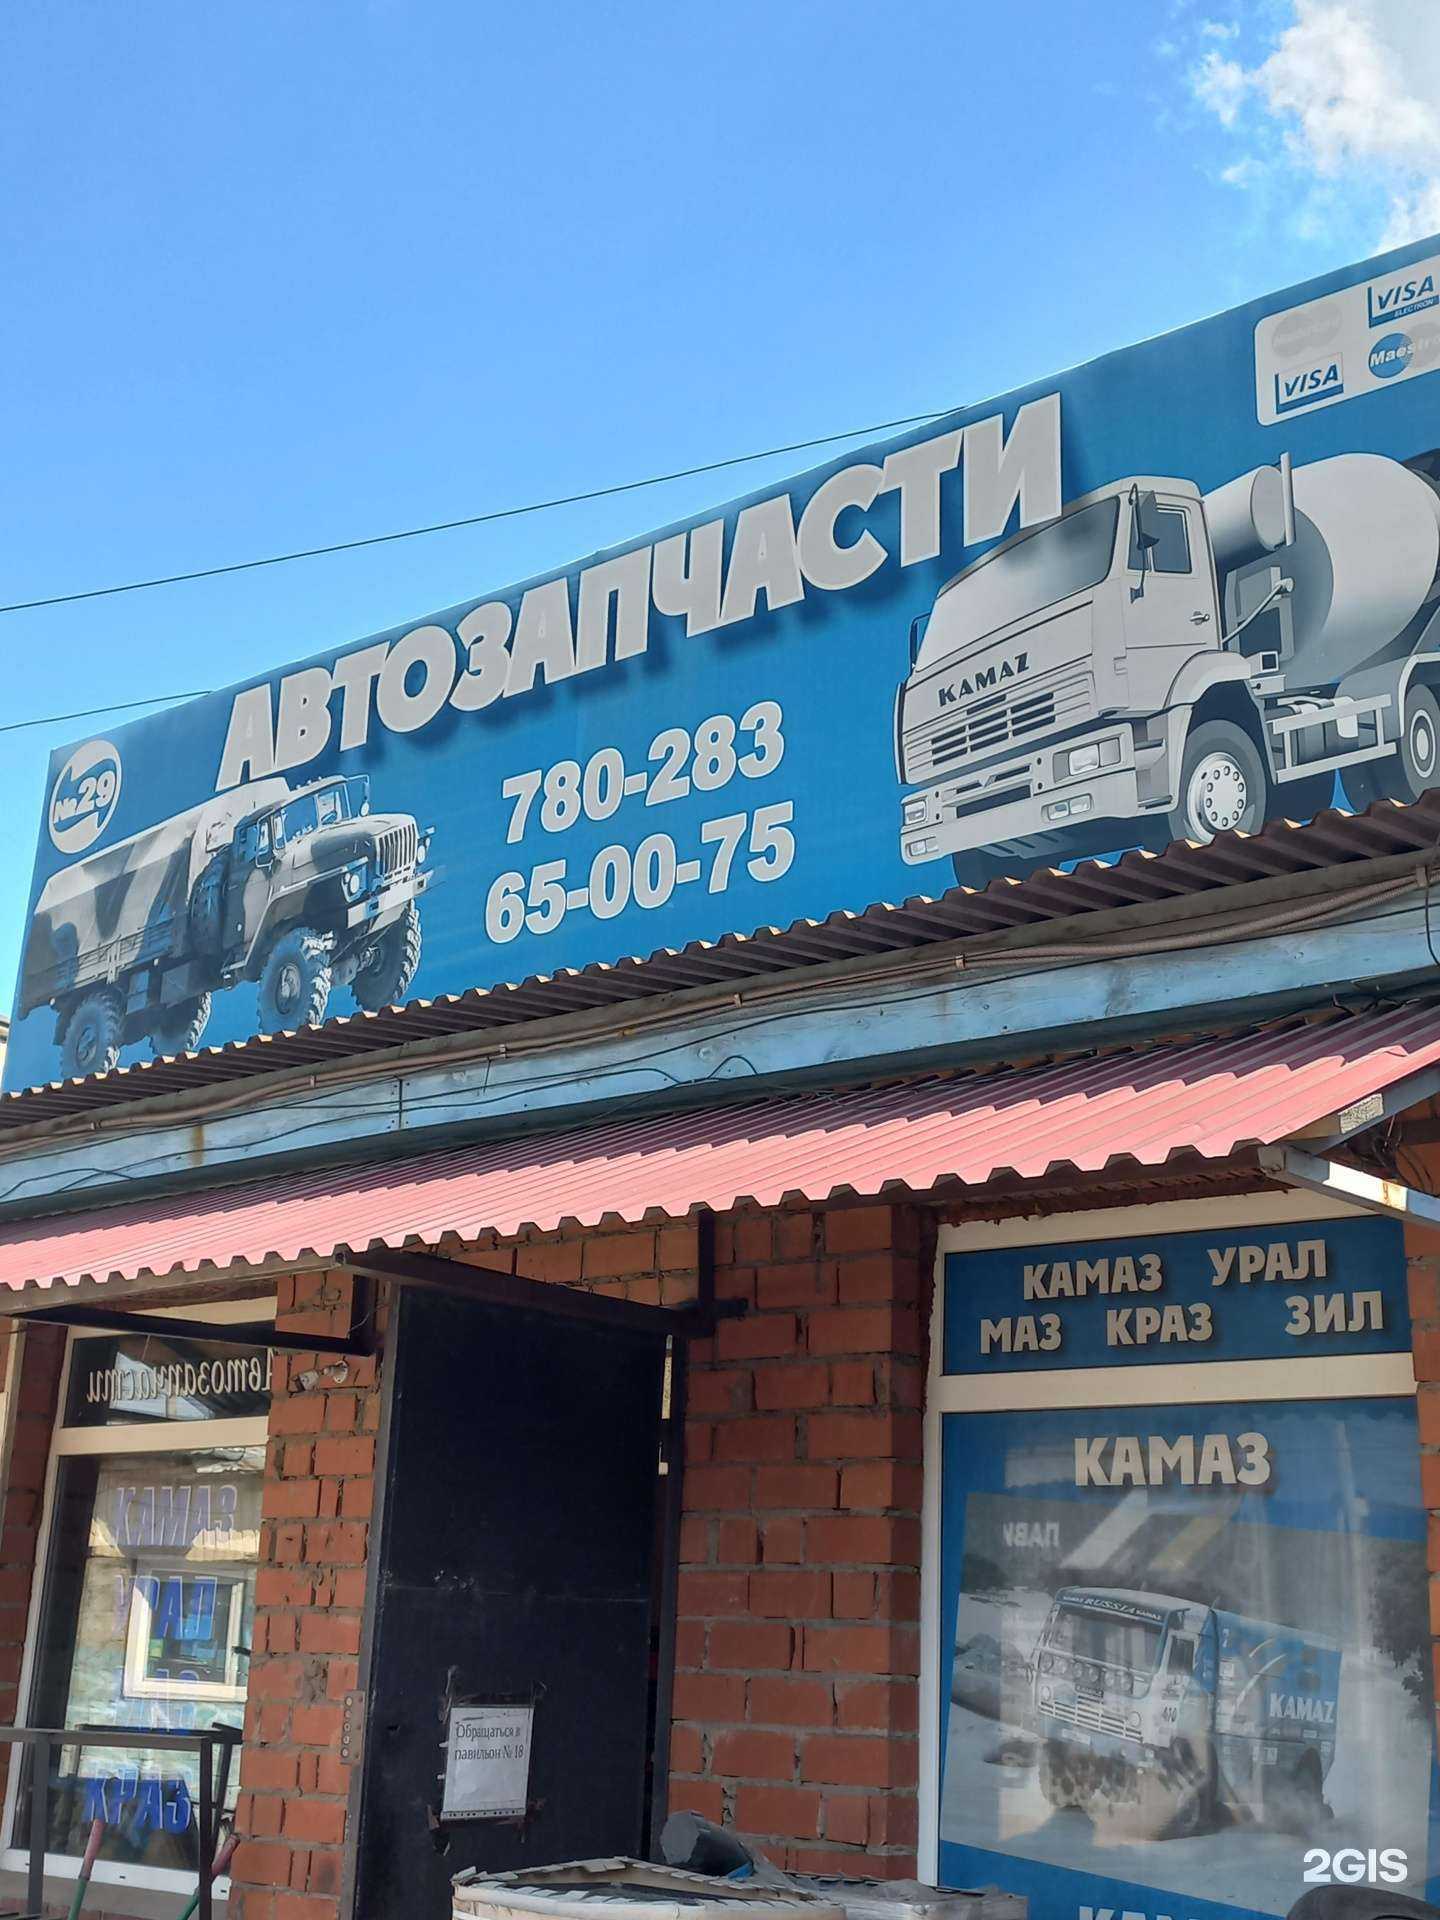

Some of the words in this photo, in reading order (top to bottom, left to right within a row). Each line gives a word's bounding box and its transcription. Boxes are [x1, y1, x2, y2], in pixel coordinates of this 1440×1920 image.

[1376, 275, 1435, 310] VISA
[1394, 297, 1435, 317] ELECTRON
[1284, 364, 1339, 397] VISA
[214, 391, 1064, 792] АВТОЗАПЧАСТИ
[937, 651, 1031, 707] KAMAZ
[500, 700, 785, 844] 780-283
[483, 801, 797, 944] 65-00-75
[1022, 1253, 1164, 1300] КАМАЗ
[1207, 1239, 1327, 1287] УРАЛ
[980, 1312, 1062, 1354] МАЗ
[1106, 1302, 1213, 1346] КРАЗ
[1285, 1291, 1384, 1336] ЗИЛ
[1073, 1431, 1272, 1487] КАМАЗ
[113, 1484, 238, 1546] КАМАЗ
[1084, 1598, 1136, 1614] RUSSIA
[456, 1723, 514, 1742] Обращаться
[1270, 1692, 1335, 1723] KAMAZ
